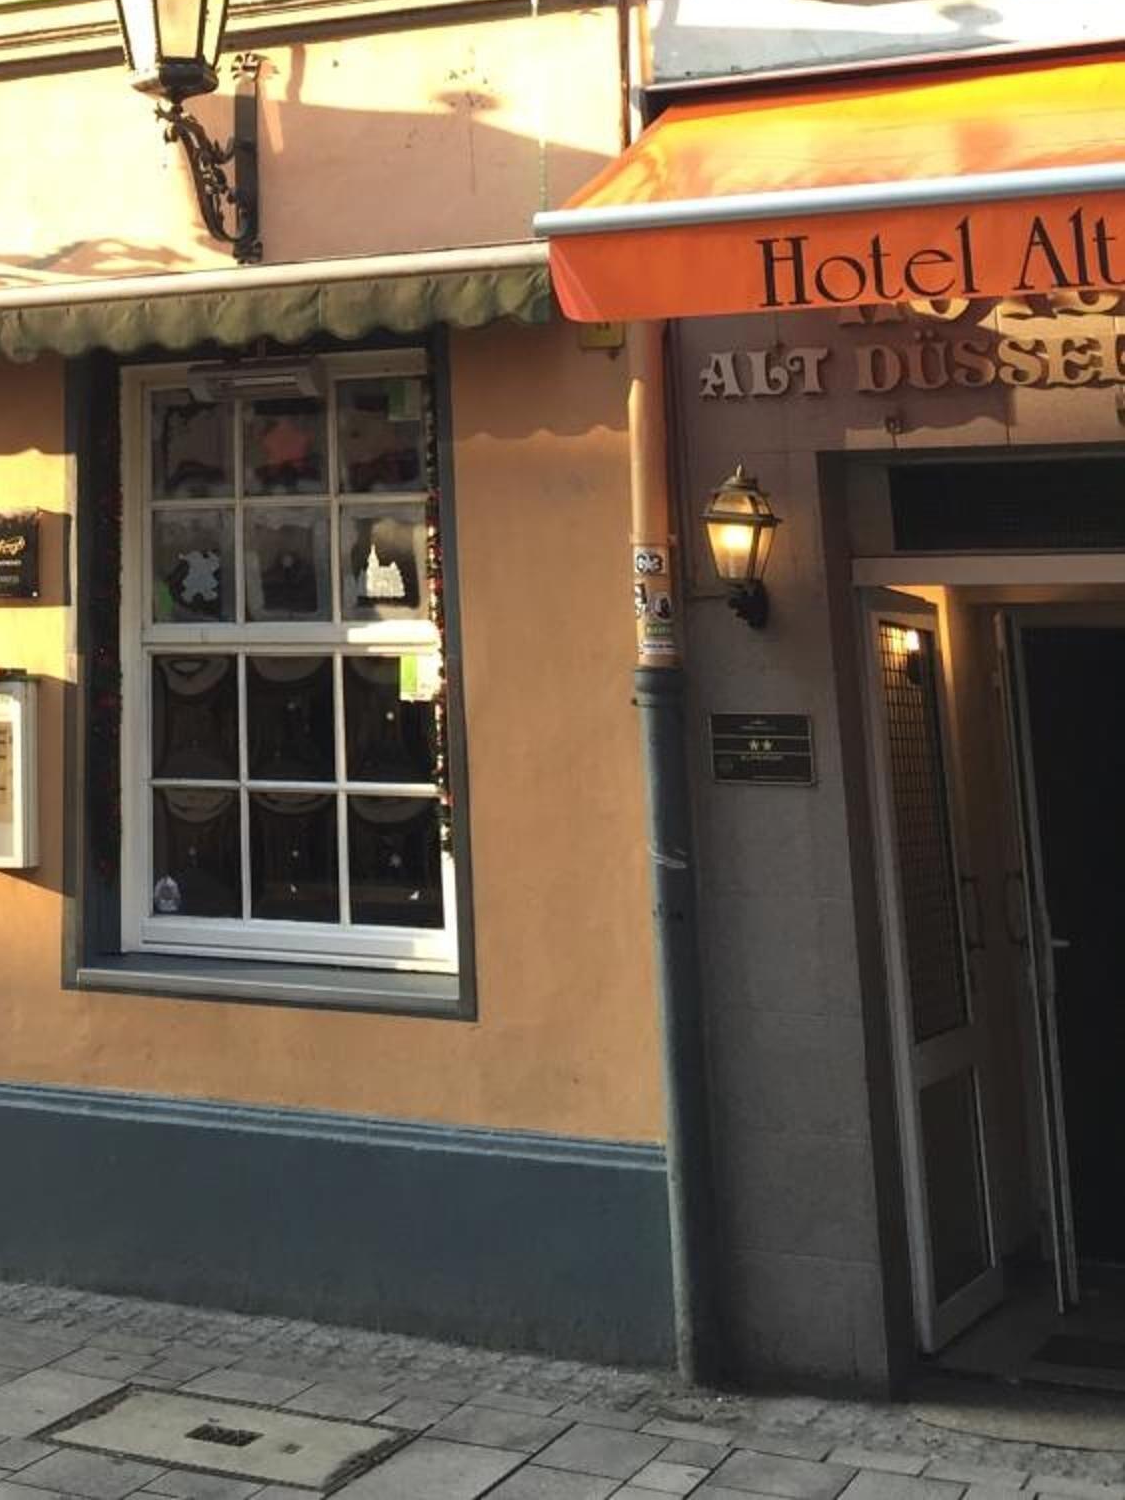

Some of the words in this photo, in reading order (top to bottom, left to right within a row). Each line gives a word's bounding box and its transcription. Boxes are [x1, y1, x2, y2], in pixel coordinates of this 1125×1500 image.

[755, 214, 979, 308] Hotel
[1013, 206, 1125, 291] Alt
[699, 342, 829, 398] ALT
